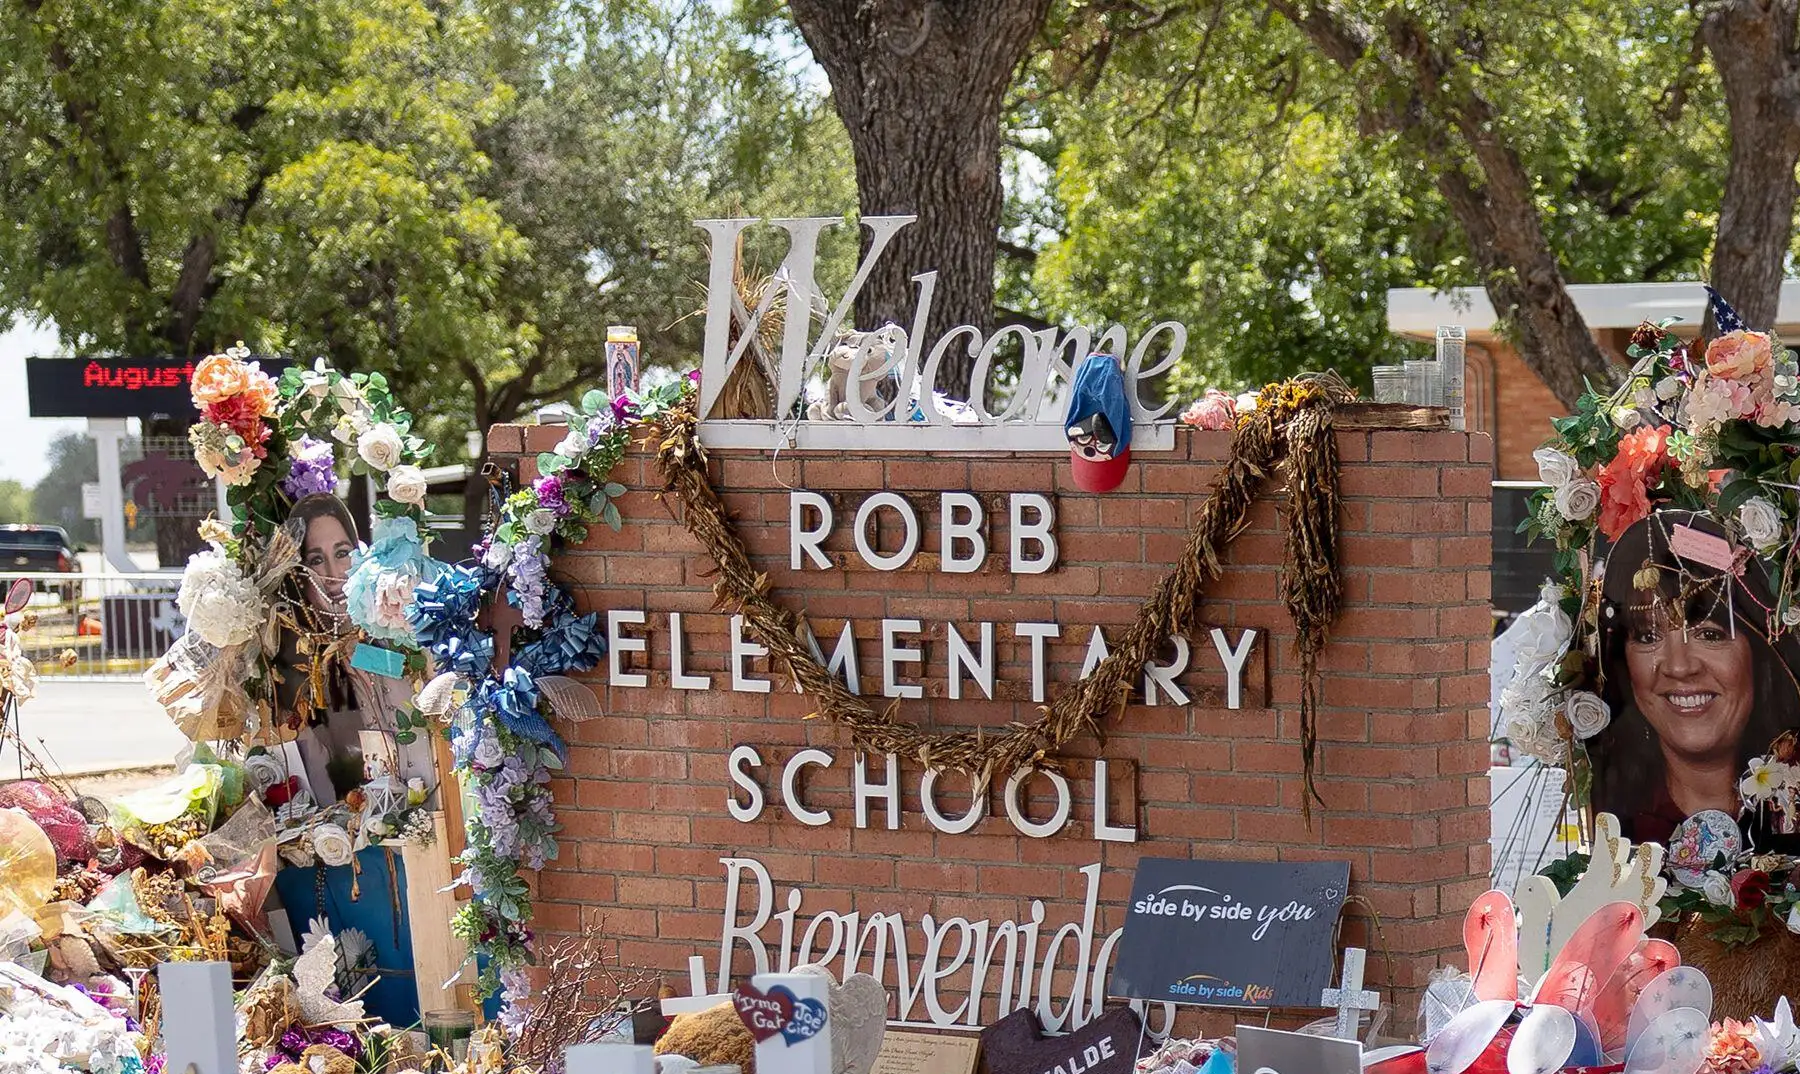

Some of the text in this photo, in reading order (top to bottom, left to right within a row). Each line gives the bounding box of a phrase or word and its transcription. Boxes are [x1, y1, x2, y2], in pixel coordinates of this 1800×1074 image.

[693, 215, 1188, 422] Welcome
[83, 360, 195, 390] August
[789, 490, 1060, 574] ROBB
[726, 744, 1139, 843] SCHOOL
[1134, 893, 1317, 942] side by side you
[1168, 980, 1275, 1004] side by side Kids
